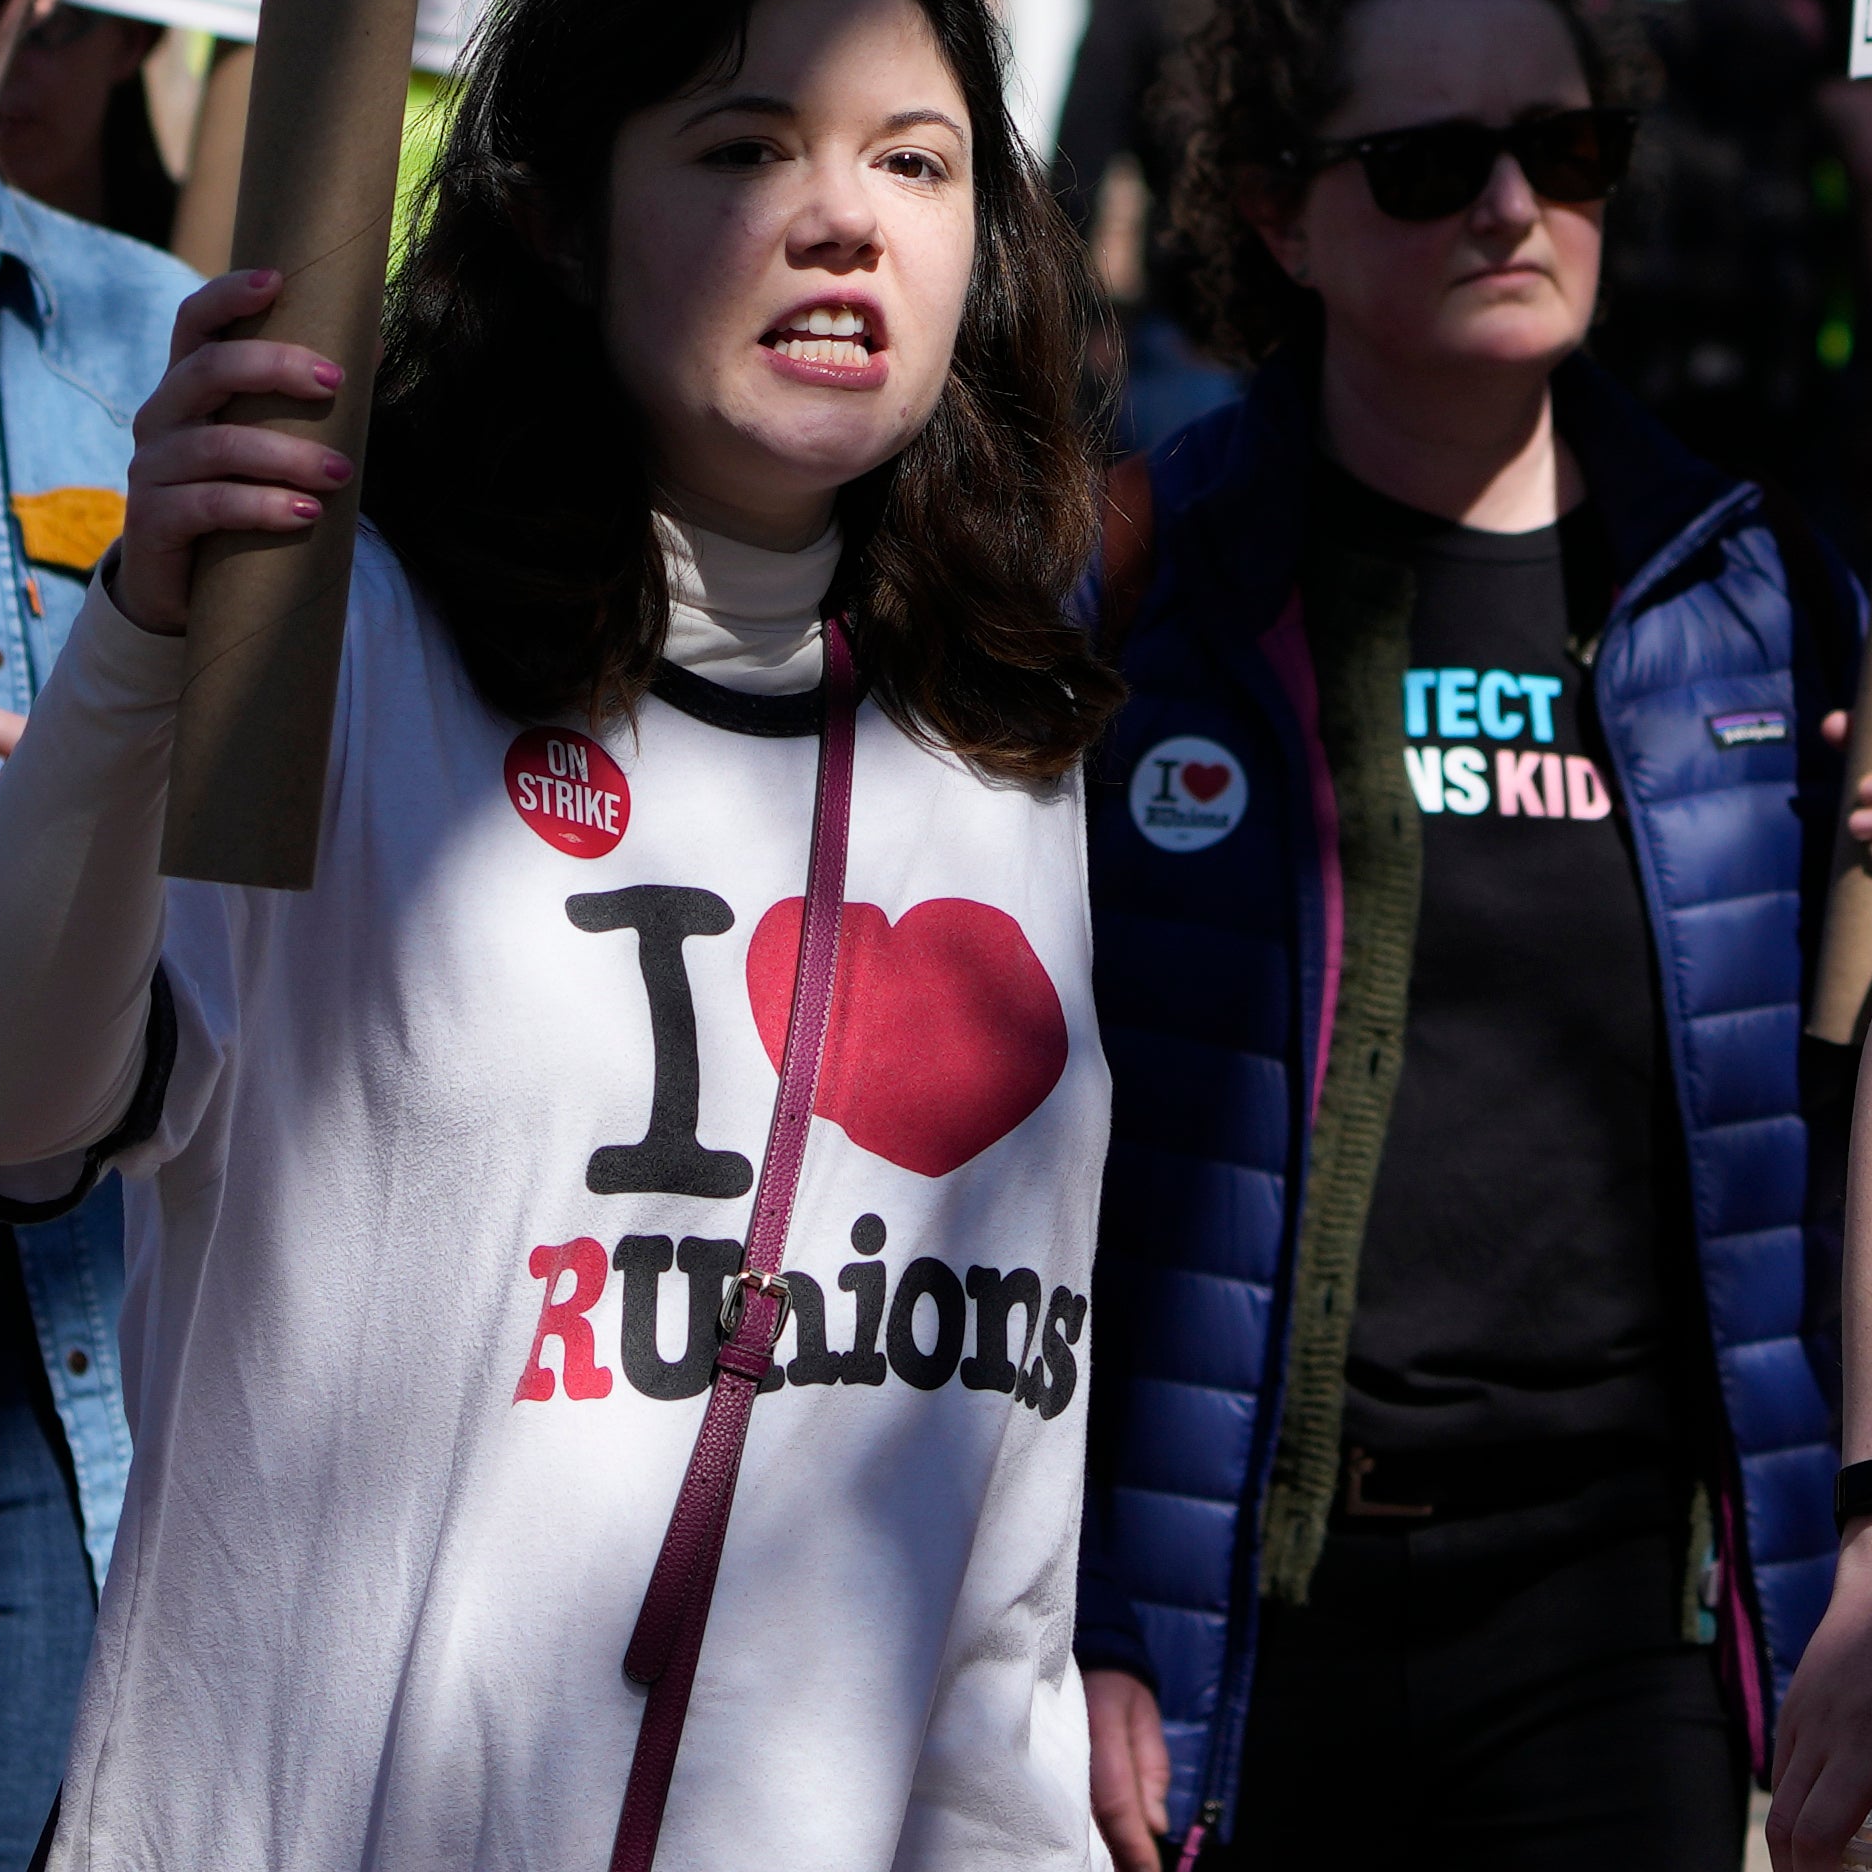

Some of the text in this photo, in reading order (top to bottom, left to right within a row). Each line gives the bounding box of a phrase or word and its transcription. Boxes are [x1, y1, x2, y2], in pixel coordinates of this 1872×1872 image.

[1403, 666, 1563, 744] TECT
[547, 739, 589, 783] ON
[1495, 748, 1612, 821] KID
[517, 771, 621, 836] STRIKE
[565, 884, 754, 1198] I
